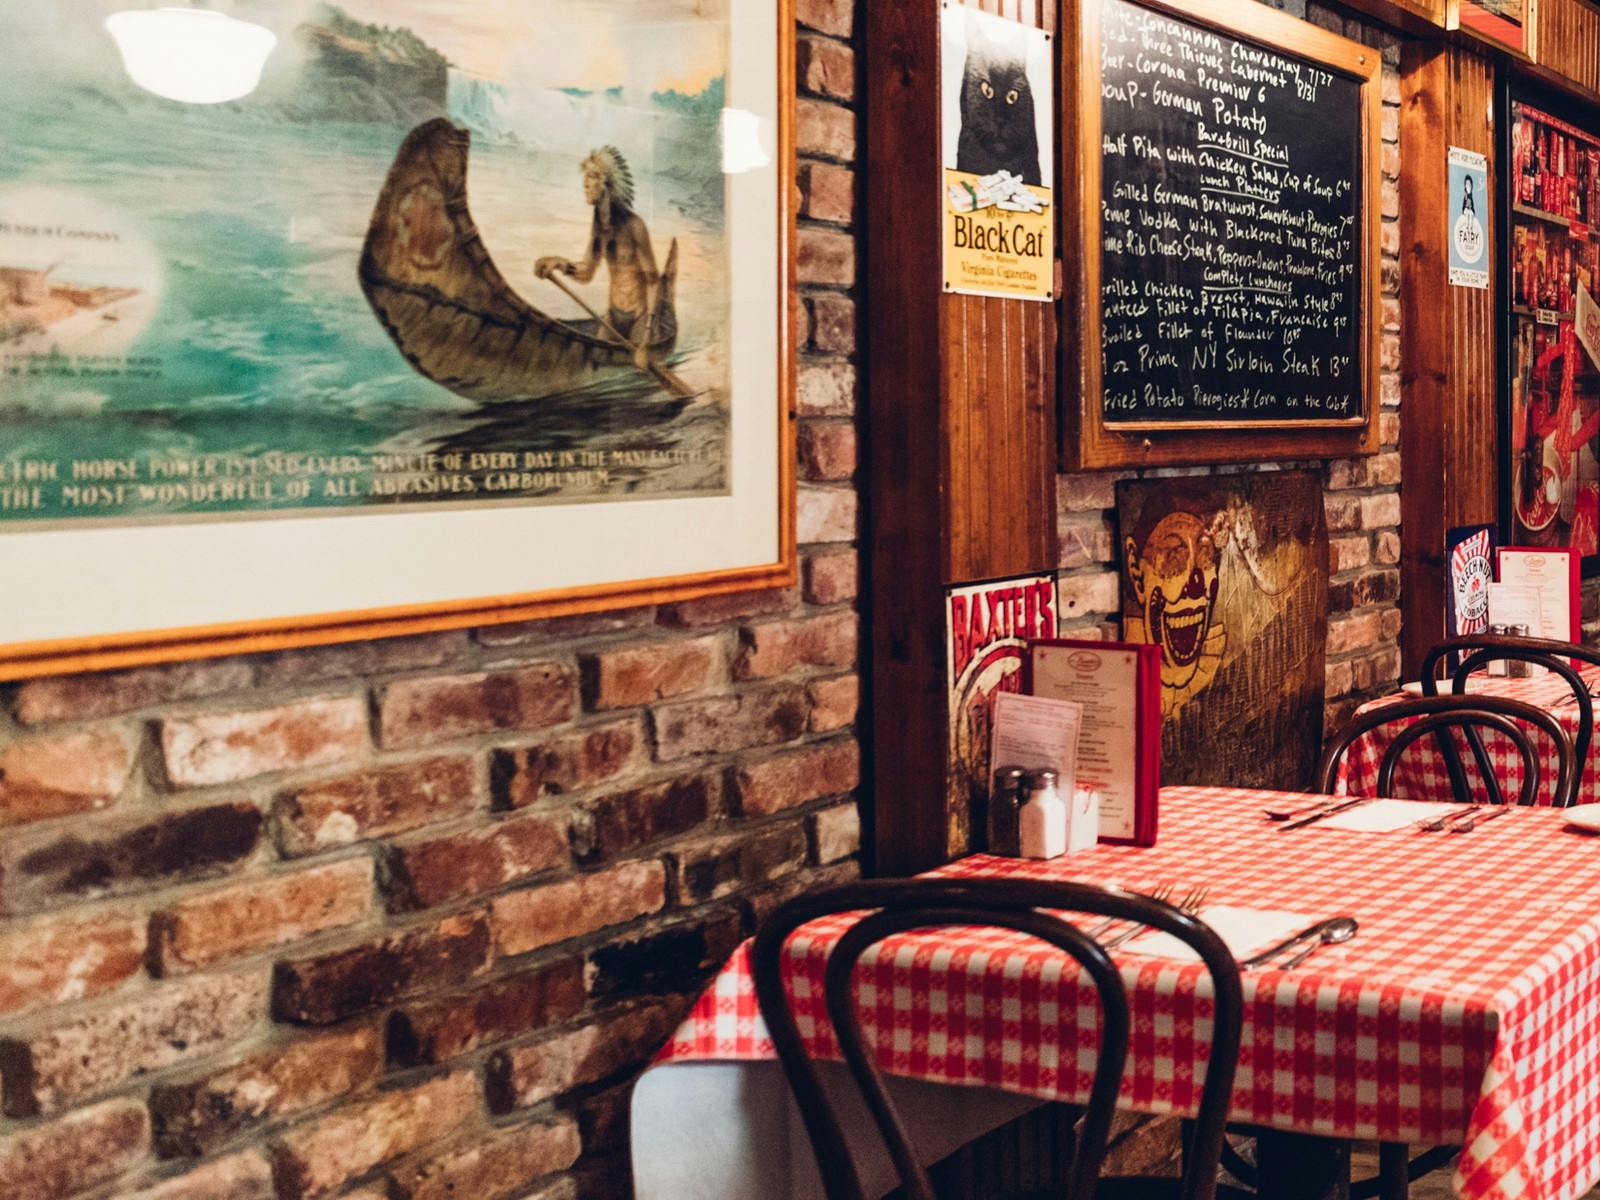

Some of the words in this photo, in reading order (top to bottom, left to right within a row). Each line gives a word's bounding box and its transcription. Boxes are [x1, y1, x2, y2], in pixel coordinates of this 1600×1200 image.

[1136, 52, 1186, 81] Corona
[1257, 86, 1266, 103] 6
[1178, 42, 1224, 74] Thieves
[1231, 60, 1288, 88] Cabernet
[1153, 80, 1203, 116] German
[1211, 97, 1266, 135] Potato
[1102, 133, 1128, 157] Half
[1132, 135, 1161, 160] Pita
[1166, 146, 1196, 167] with
[1199, 151, 1248, 178] Chicken
[1303, 174, 1313, 193] of
[1253, 139, 1289, 163] Special
[1154, 184, 1198, 210] German
[954, 214, 1010, 254] Black
[1012, 223, 1043, 258] Cat
[1189, 215, 1213, 238] with
[1286, 230, 1307, 250] Tuna
[1145, 281, 1194, 300] Chicken
[1304, 294, 1329, 313] Style
[1157, 298, 1188, 317] Fillet
[1158, 321, 1193, 339] Fillet
[1201, 321, 1215, 341] of
[1138, 343, 1178, 373] Prime
[1192, 341, 1217, 371] NY
[1226, 347, 1274, 374] Sirloin
[1281, 347, 1320, 377] Steak
[1104, 388, 1138, 412] Fried
[1143, 382, 1185, 408] Potato
[1286, 396, 1299, 407] on
[72, 458, 137, 481] HORSE
[150, 457, 221, 479] POWER
[370, 453, 438, 473] MINUTE
[443, 452, 466, 471] OF
[470, 451, 518, 471] EVERY
[524, 450, 554, 469] DAY
[559, 449, 575, 467] IN
[580, 448, 605, 467] THE
[62, 483, 126, 506] MOST
[138, 477, 273, 503] WONDERFUL
[286, 479, 313, 498] OF
[322, 477, 360, 498] ALL
[369, 473, 480, 496] ABRASIVES,
